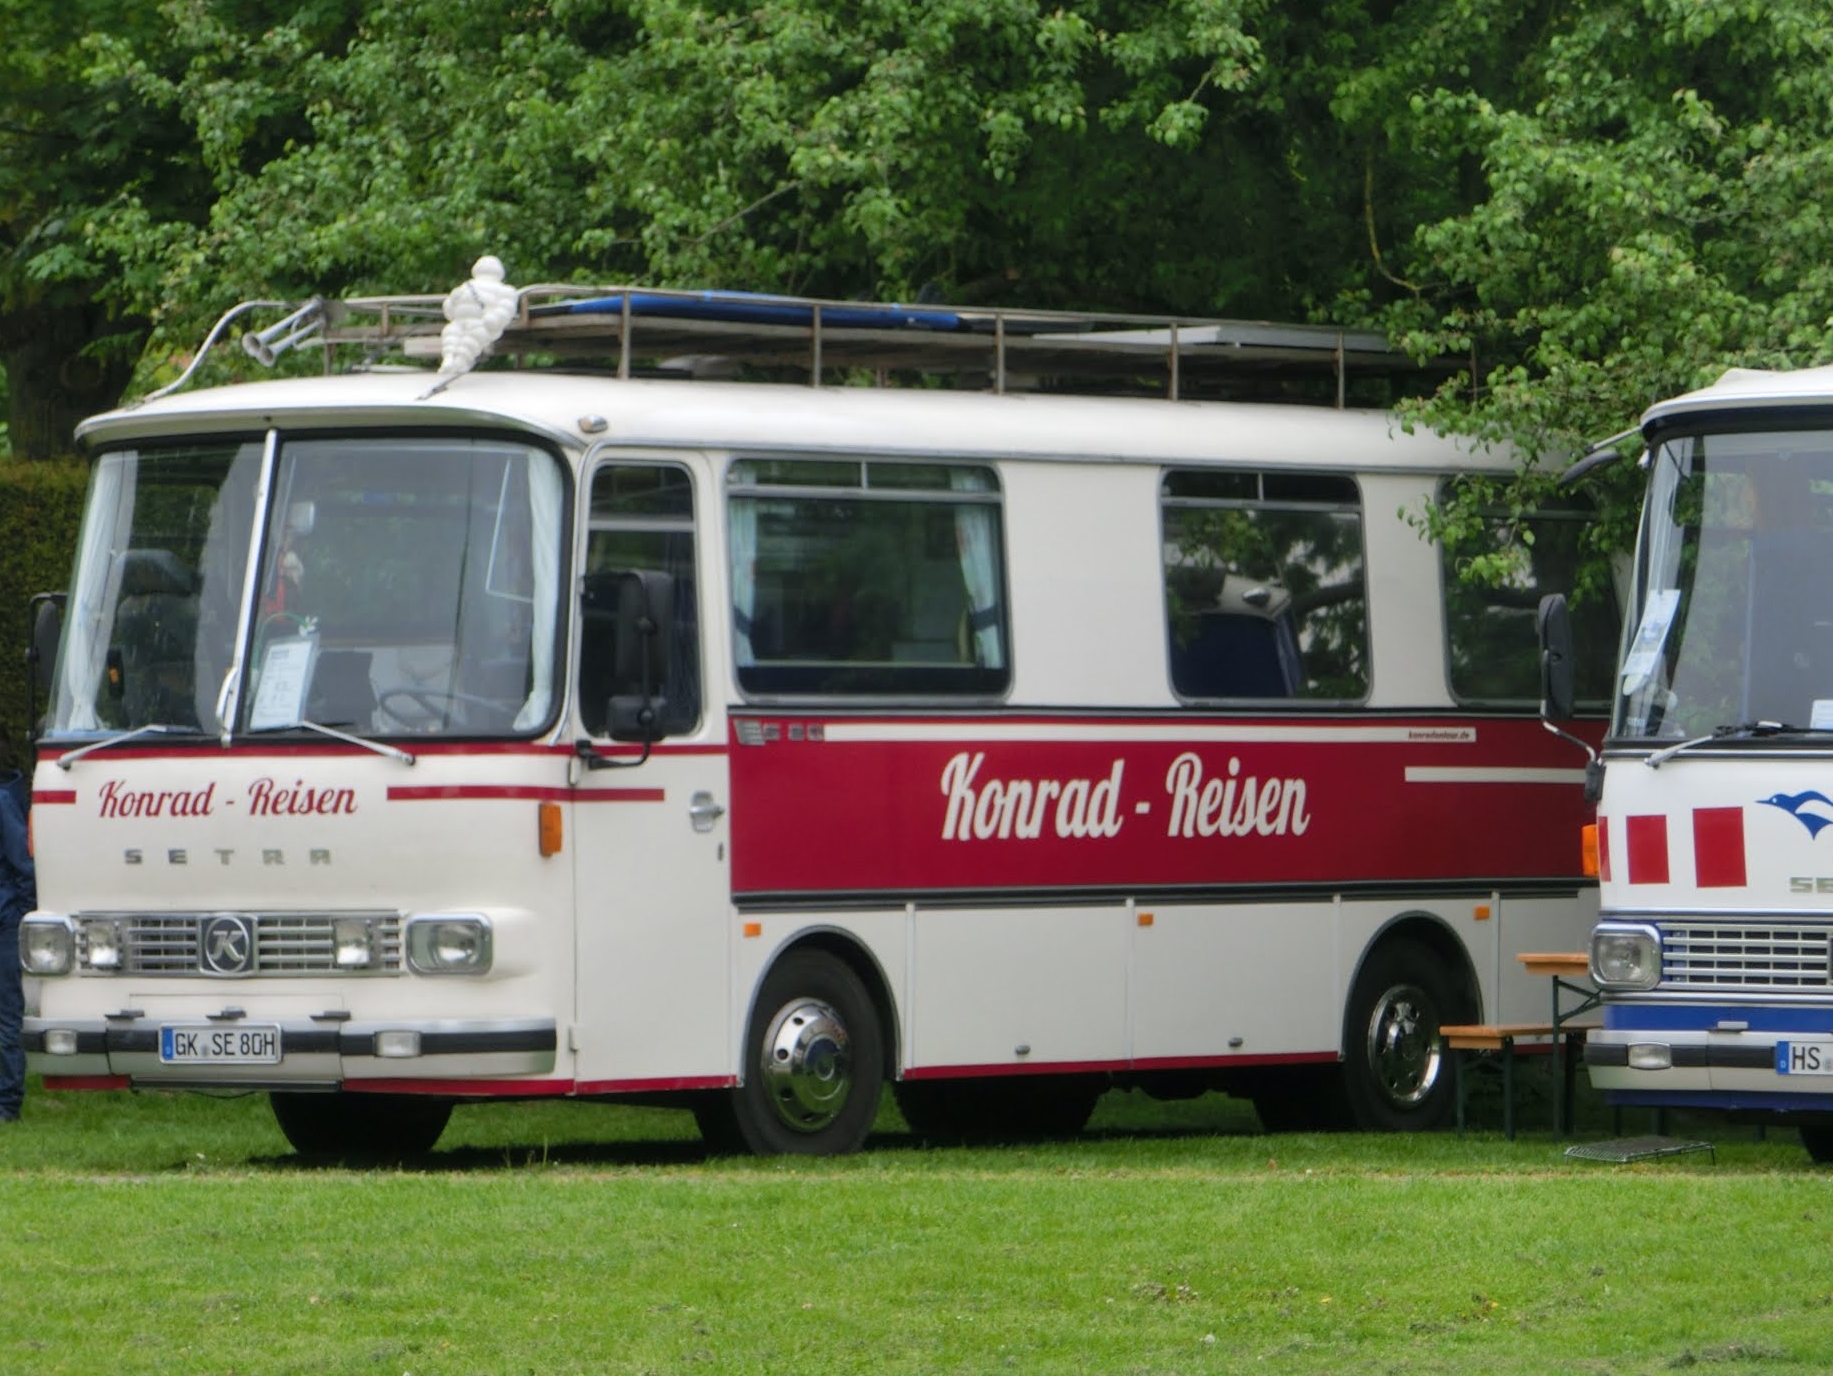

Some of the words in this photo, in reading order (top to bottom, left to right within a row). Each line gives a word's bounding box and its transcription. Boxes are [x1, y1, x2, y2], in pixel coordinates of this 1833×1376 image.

[98, 780, 215, 818] Konrad
[248, 777, 358, 817] Reisen
[940, 751, 1124, 841] Konrad
[1166, 751, 1311, 839] Reisen
[124, 849, 332, 865] SETRA
[175, 1033, 198, 1056] GK
[212, 1033, 235, 1056] SE
[240, 1033, 275, 1056] 80H
[1792, 1046, 1820, 1071] HS
